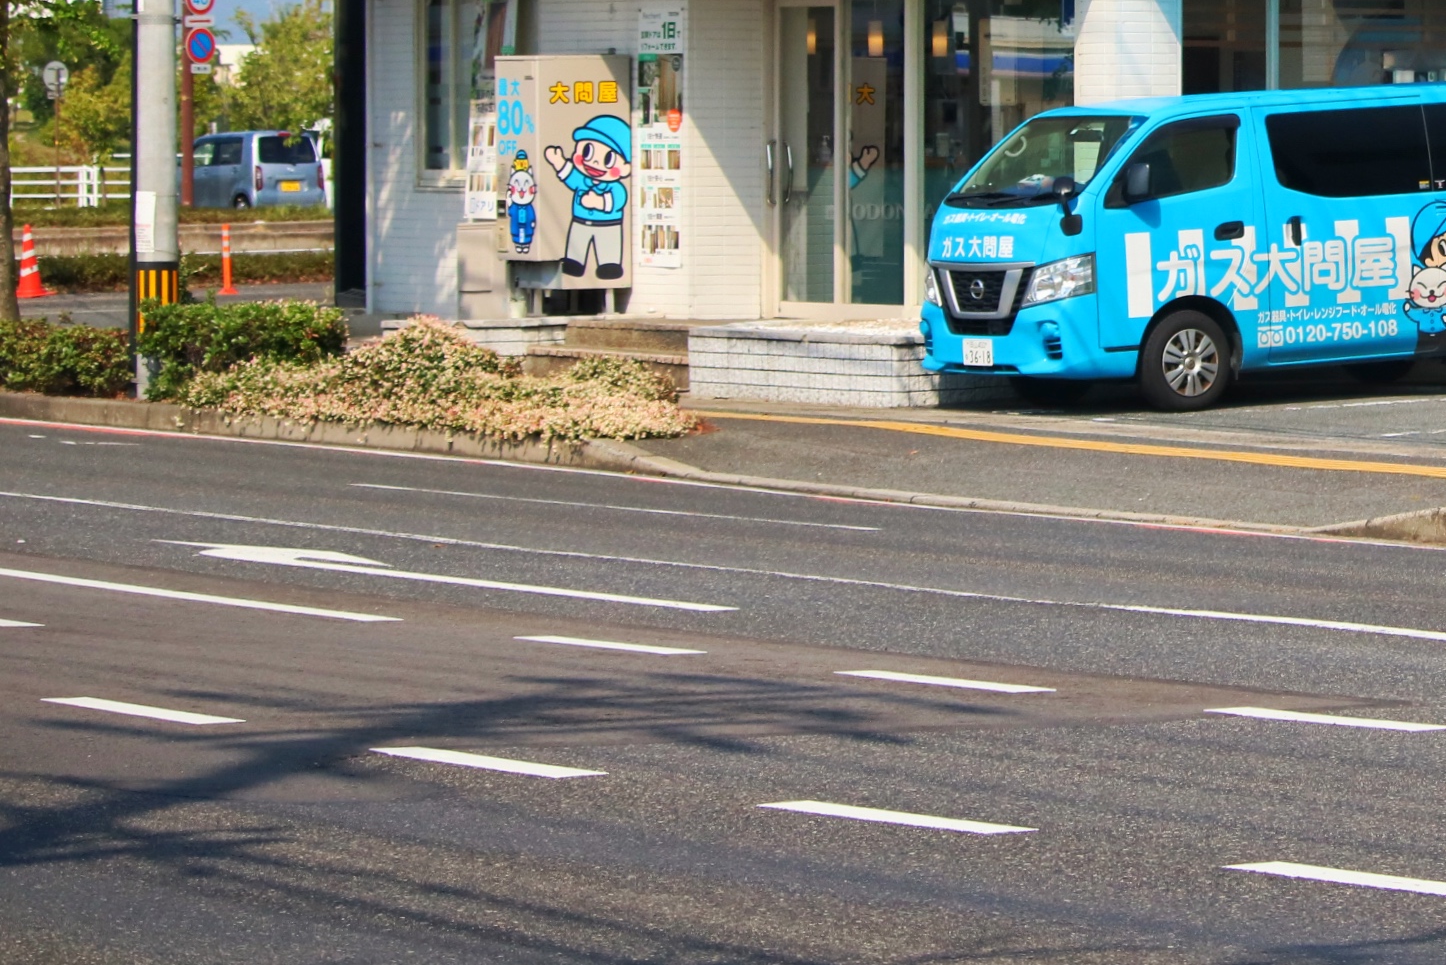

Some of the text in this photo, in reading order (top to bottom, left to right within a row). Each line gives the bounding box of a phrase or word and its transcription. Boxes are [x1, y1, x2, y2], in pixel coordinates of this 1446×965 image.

[498, 78, 520, 96] 最大
[549, 80, 619, 104] 大問屋
[497, 100, 535, 135] 80%
[498, 140, 517, 155] OFF
[942, 235, 1014, 258] ガス大問屋
[1156, 236, 1396, 302] ガス大問屋
[1285, 319, 1398, 344] 0120-750-108
